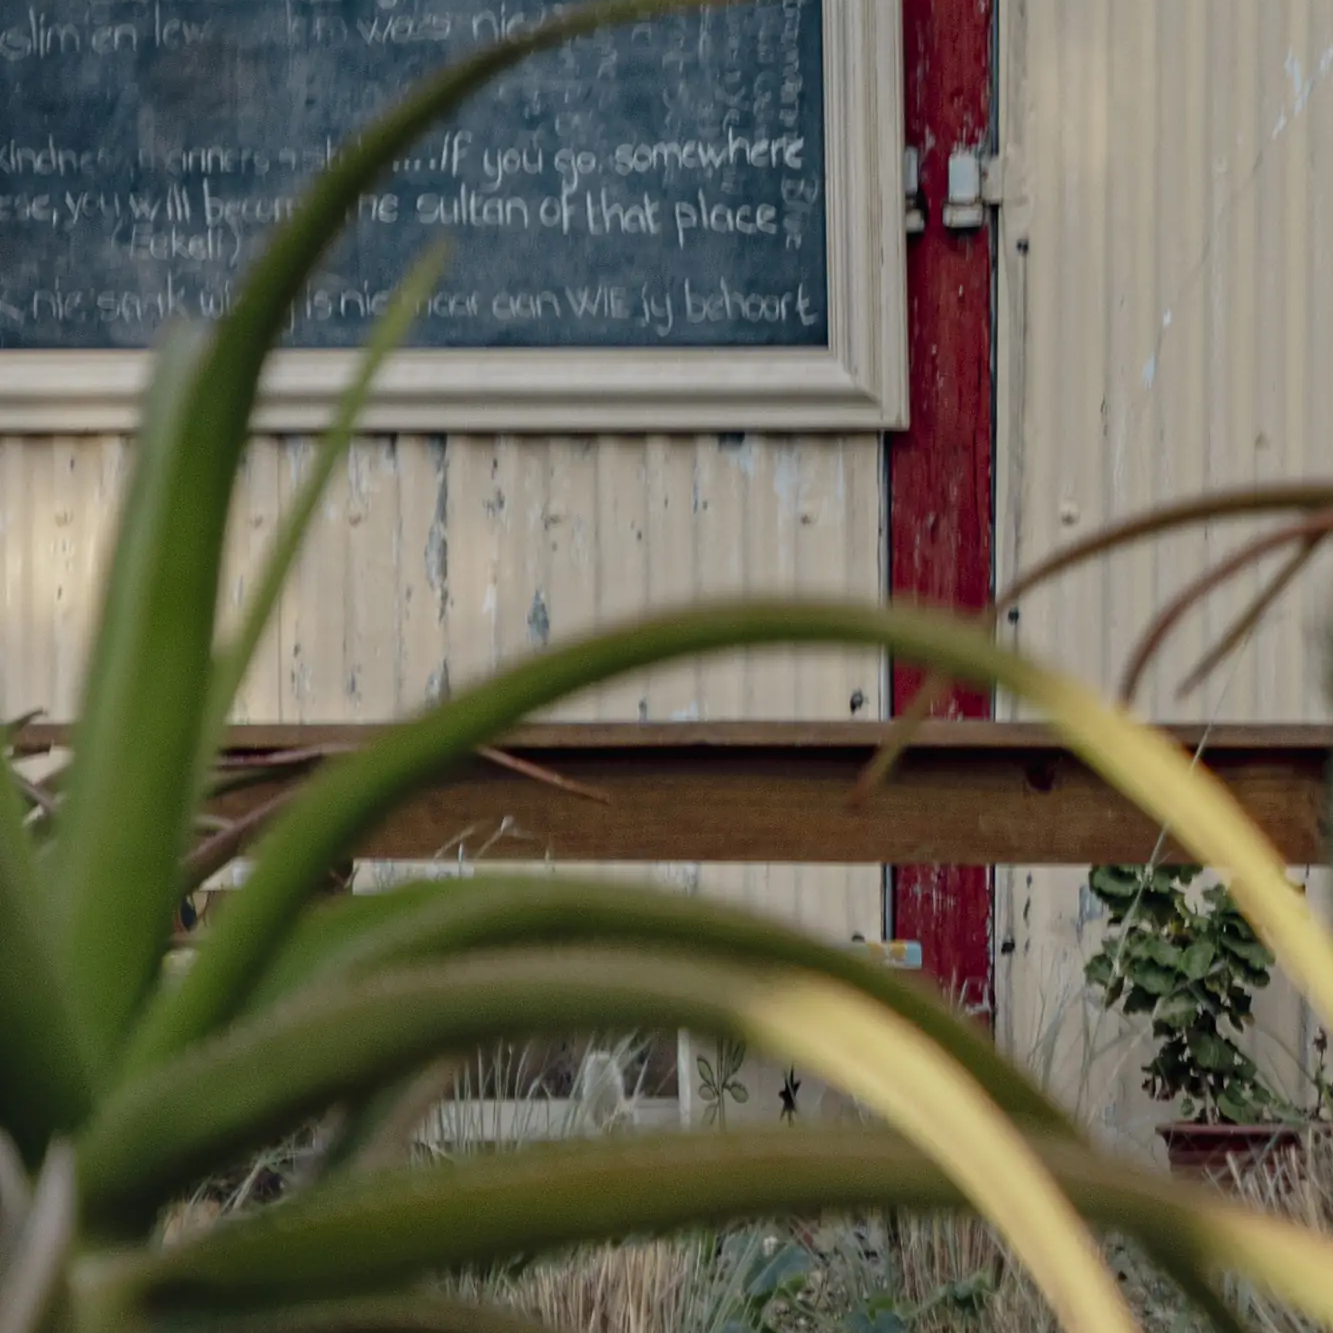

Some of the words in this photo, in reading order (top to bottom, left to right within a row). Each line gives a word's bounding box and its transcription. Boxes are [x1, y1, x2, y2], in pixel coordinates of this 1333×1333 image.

[482, 147, 543, 192] you
[614, 127, 804, 176] somewhere
[417, 182, 529, 228] sultan
[675, 187, 778, 249] place
[563, 285, 628, 321] WIE
